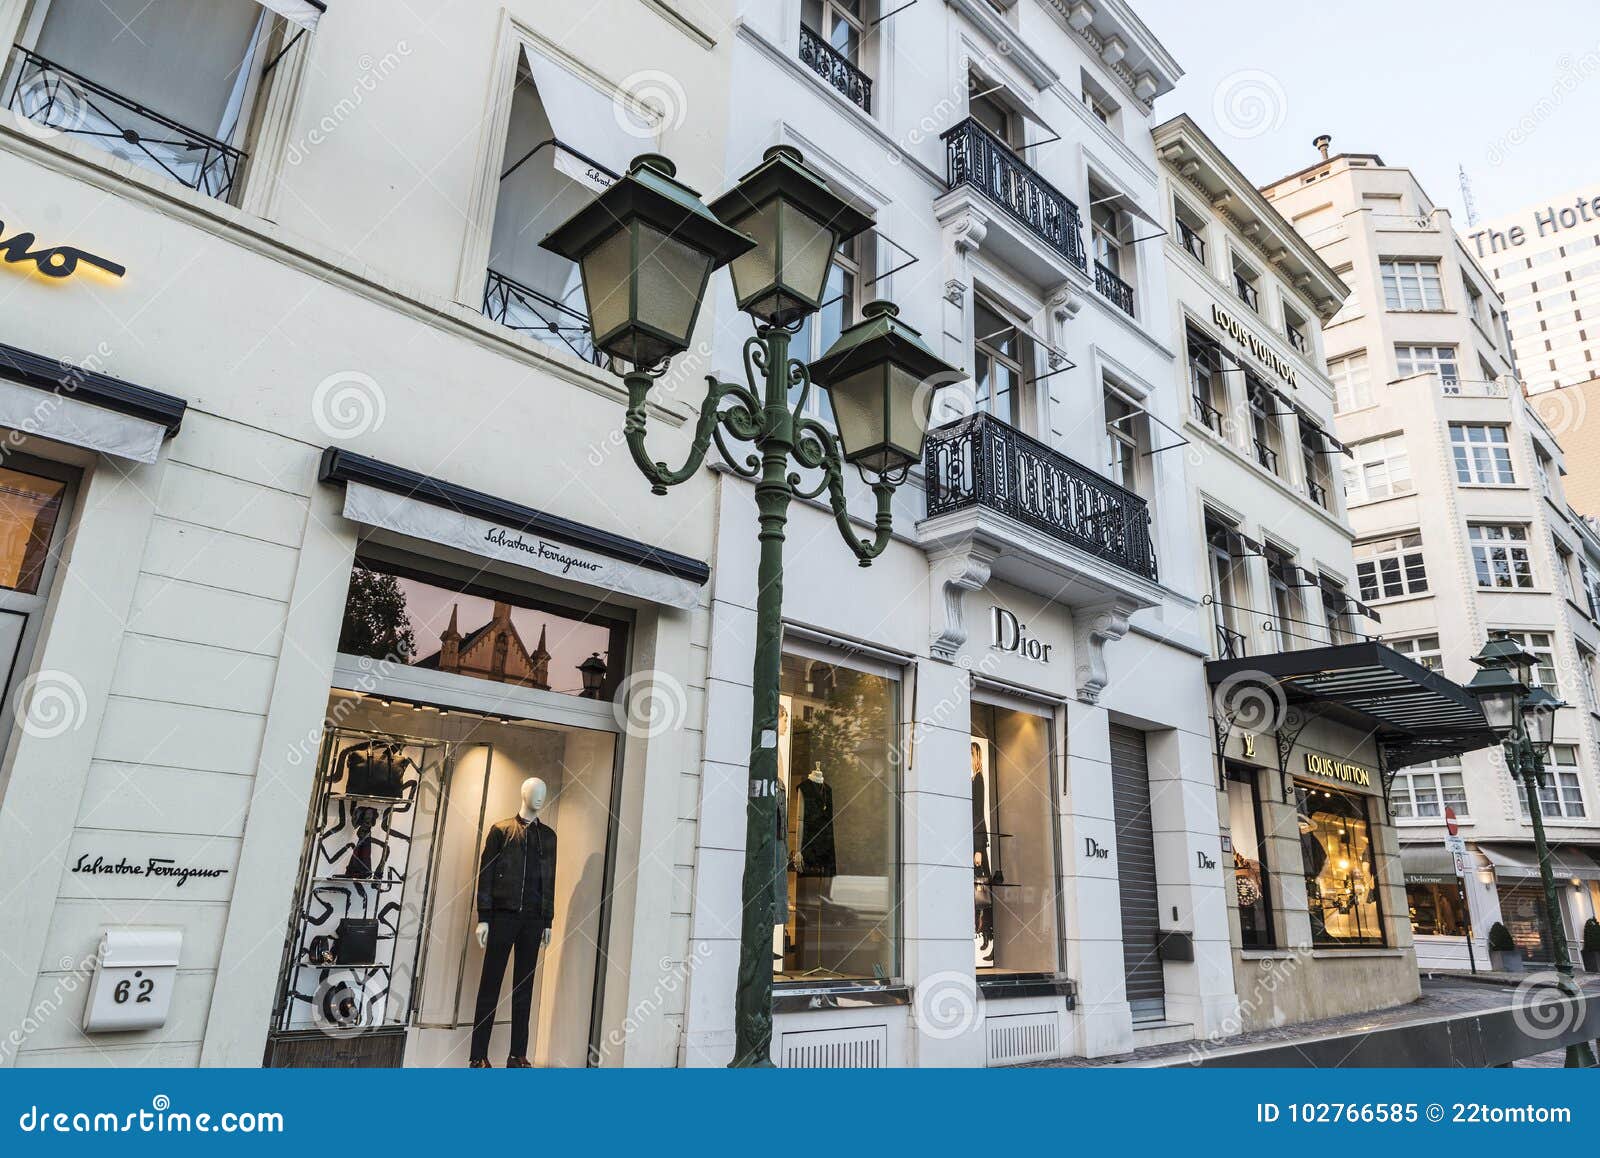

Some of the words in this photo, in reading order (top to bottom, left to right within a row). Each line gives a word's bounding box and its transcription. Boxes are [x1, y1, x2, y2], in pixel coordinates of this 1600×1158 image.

[1468, 226, 1526, 258] The
[1212, 304, 1250, 347] LOUIS
[1248, 335, 1298, 389] VUITTON
[484, 527, 538, 555] Salvatore
[538, 540, 604, 574] Ferragamo
[988, 605, 1052, 663] Dior
[1307, 753, 1334, 777] LOUIS
[1333, 762, 1370, 786] VUITTON
[1085, 837, 1109, 859] Dior
[1197, 851, 1216, 870] Dior
[72, 853, 144, 875] Salvatore
[145, 858, 229, 887] Ferragamo
[114, 979, 154, 1004] 62
